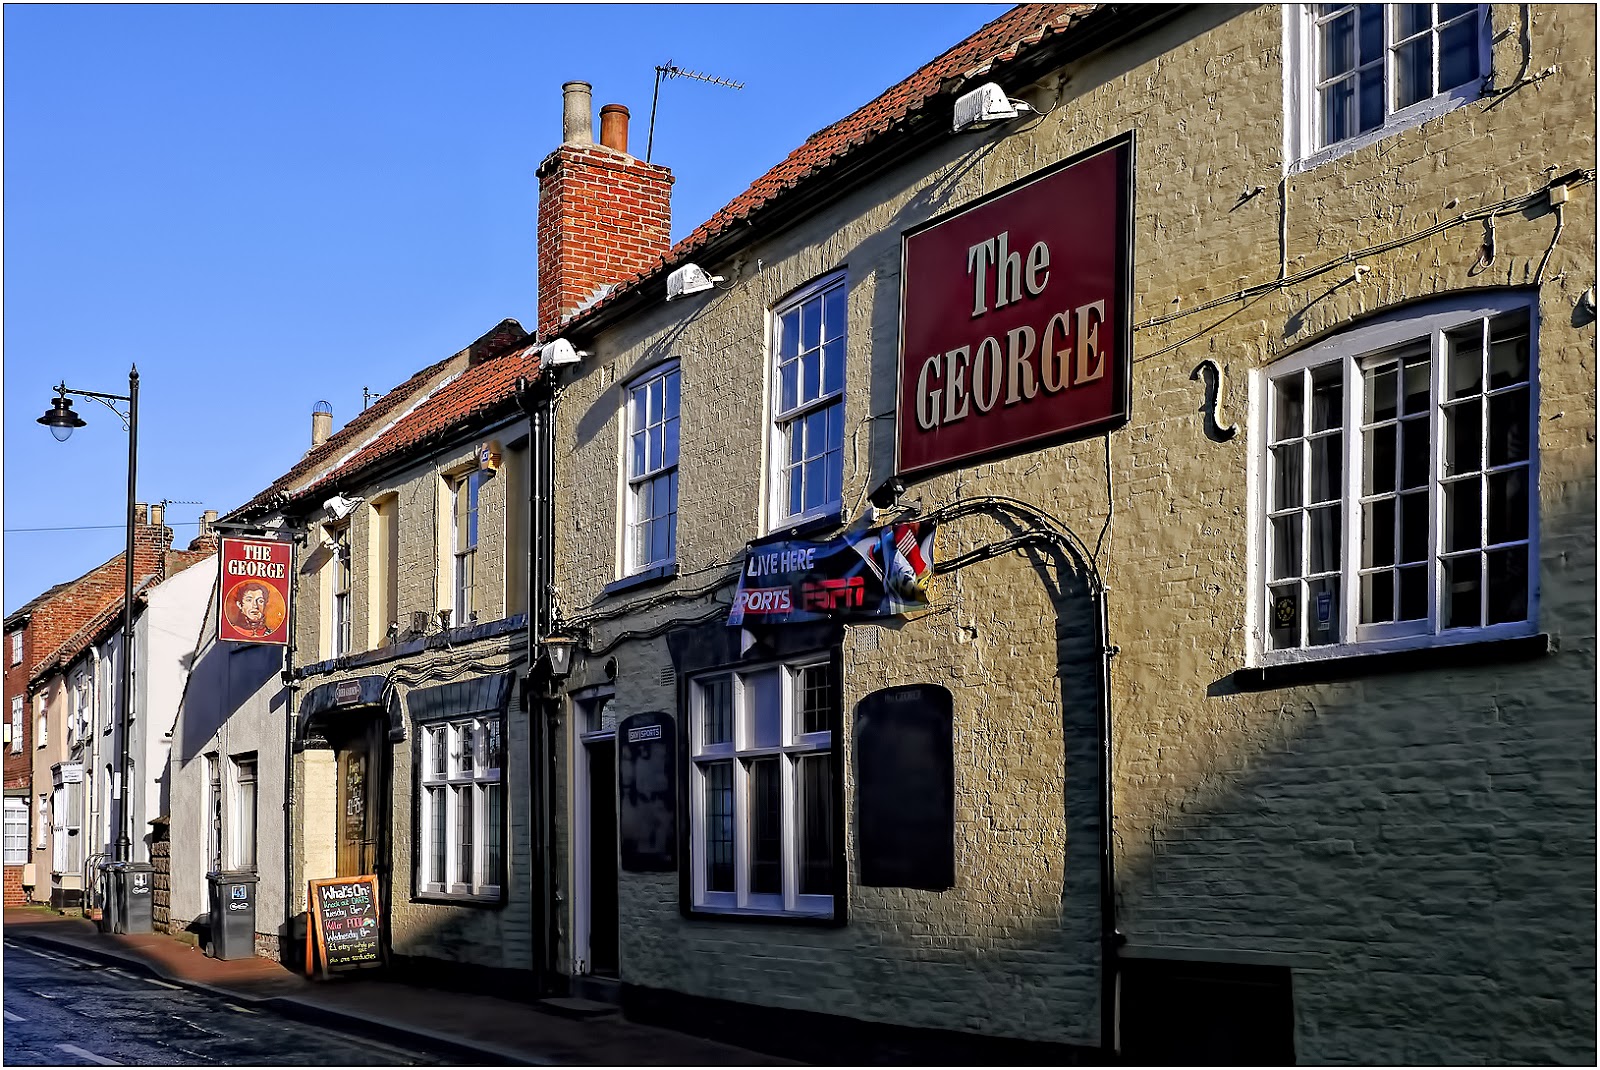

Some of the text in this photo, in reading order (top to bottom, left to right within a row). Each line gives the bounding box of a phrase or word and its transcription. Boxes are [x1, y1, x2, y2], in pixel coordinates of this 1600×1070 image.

[968, 231, 1050, 317] The
[916, 299, 1106, 430] GEORGE
[243, 544, 272, 562] THE
[228, 559, 285, 579] GEORGE
[747, 547, 816, 577] LIVE HERE
[802, 576, 865, 610] ESPN
[641, 728, 659, 738] SPORTS
[234, 888, 246, 898] 41
[322, 884, 370, 900] What's On:
[324, 900, 340, 908] Knock
[323, 909, 347, 918] Tuesday
[347, 918, 363, 928] POOL
[326, 930, 358, 942] Wednesday
